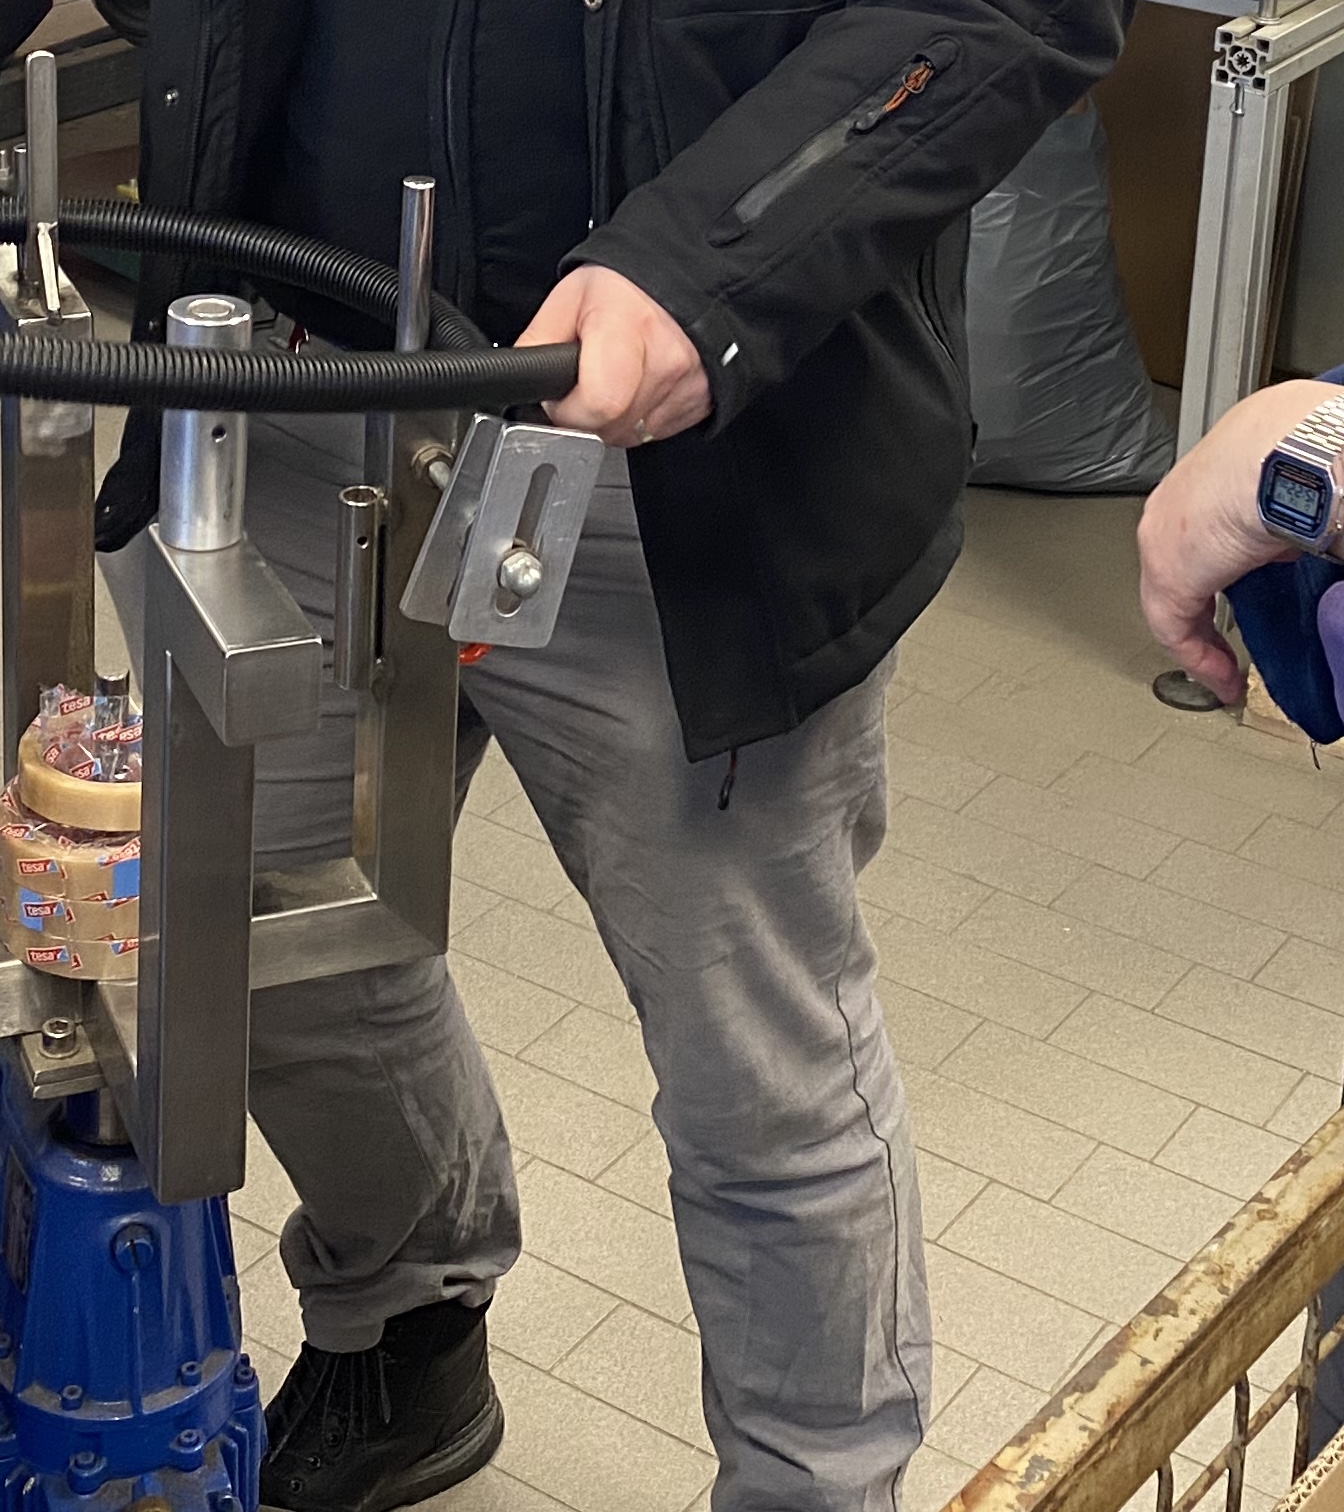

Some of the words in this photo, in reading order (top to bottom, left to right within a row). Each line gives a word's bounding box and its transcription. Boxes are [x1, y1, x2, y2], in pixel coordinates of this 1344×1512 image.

[61, 696, 91, 714] tesa
[21, 862, 45, 873] tesa
[27, 905, 51, 916] tesa
[30, 951, 55, 962] tesa
